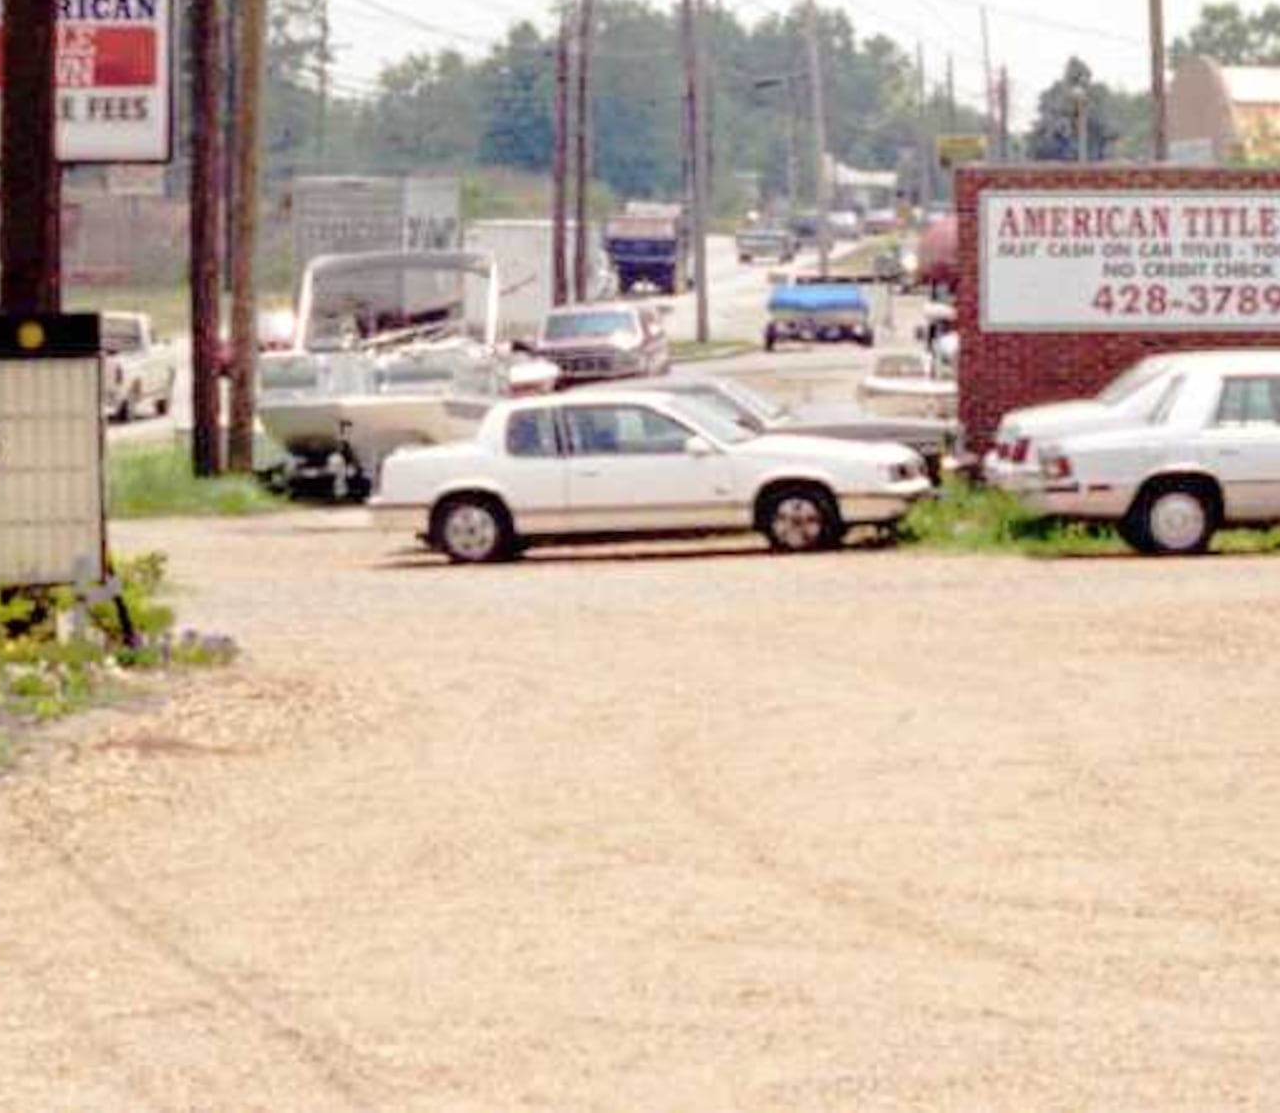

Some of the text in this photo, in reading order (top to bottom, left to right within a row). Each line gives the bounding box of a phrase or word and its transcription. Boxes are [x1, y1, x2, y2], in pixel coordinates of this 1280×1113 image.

[87, 96, 149, 121] FEES
[997, 207, 1172, 238] AMERICAN
[1181, 206, 1279, 238] TITLE
[1047, 242, 1095, 258] CASH
[1102, 242, 1132, 258] ON
[1102, 261, 1276, 278] NO CREDIT CHECK
